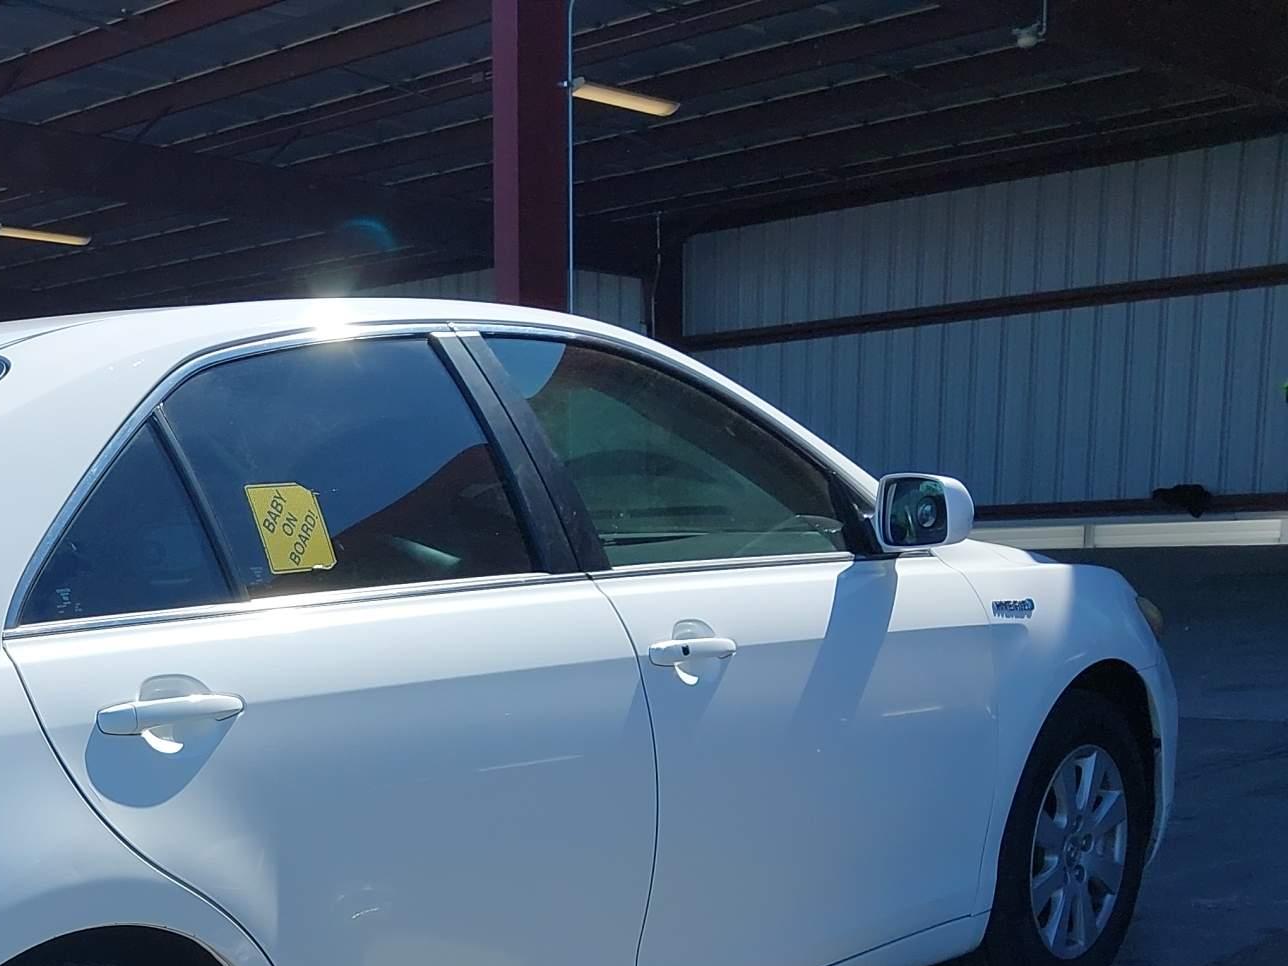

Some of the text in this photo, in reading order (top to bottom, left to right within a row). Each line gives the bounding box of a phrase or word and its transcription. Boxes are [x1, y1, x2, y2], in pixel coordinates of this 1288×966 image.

[263, 489, 287, 534] BABY
[282, 512, 298, 537] ON
[289, 510, 319, 566] BOARD!
